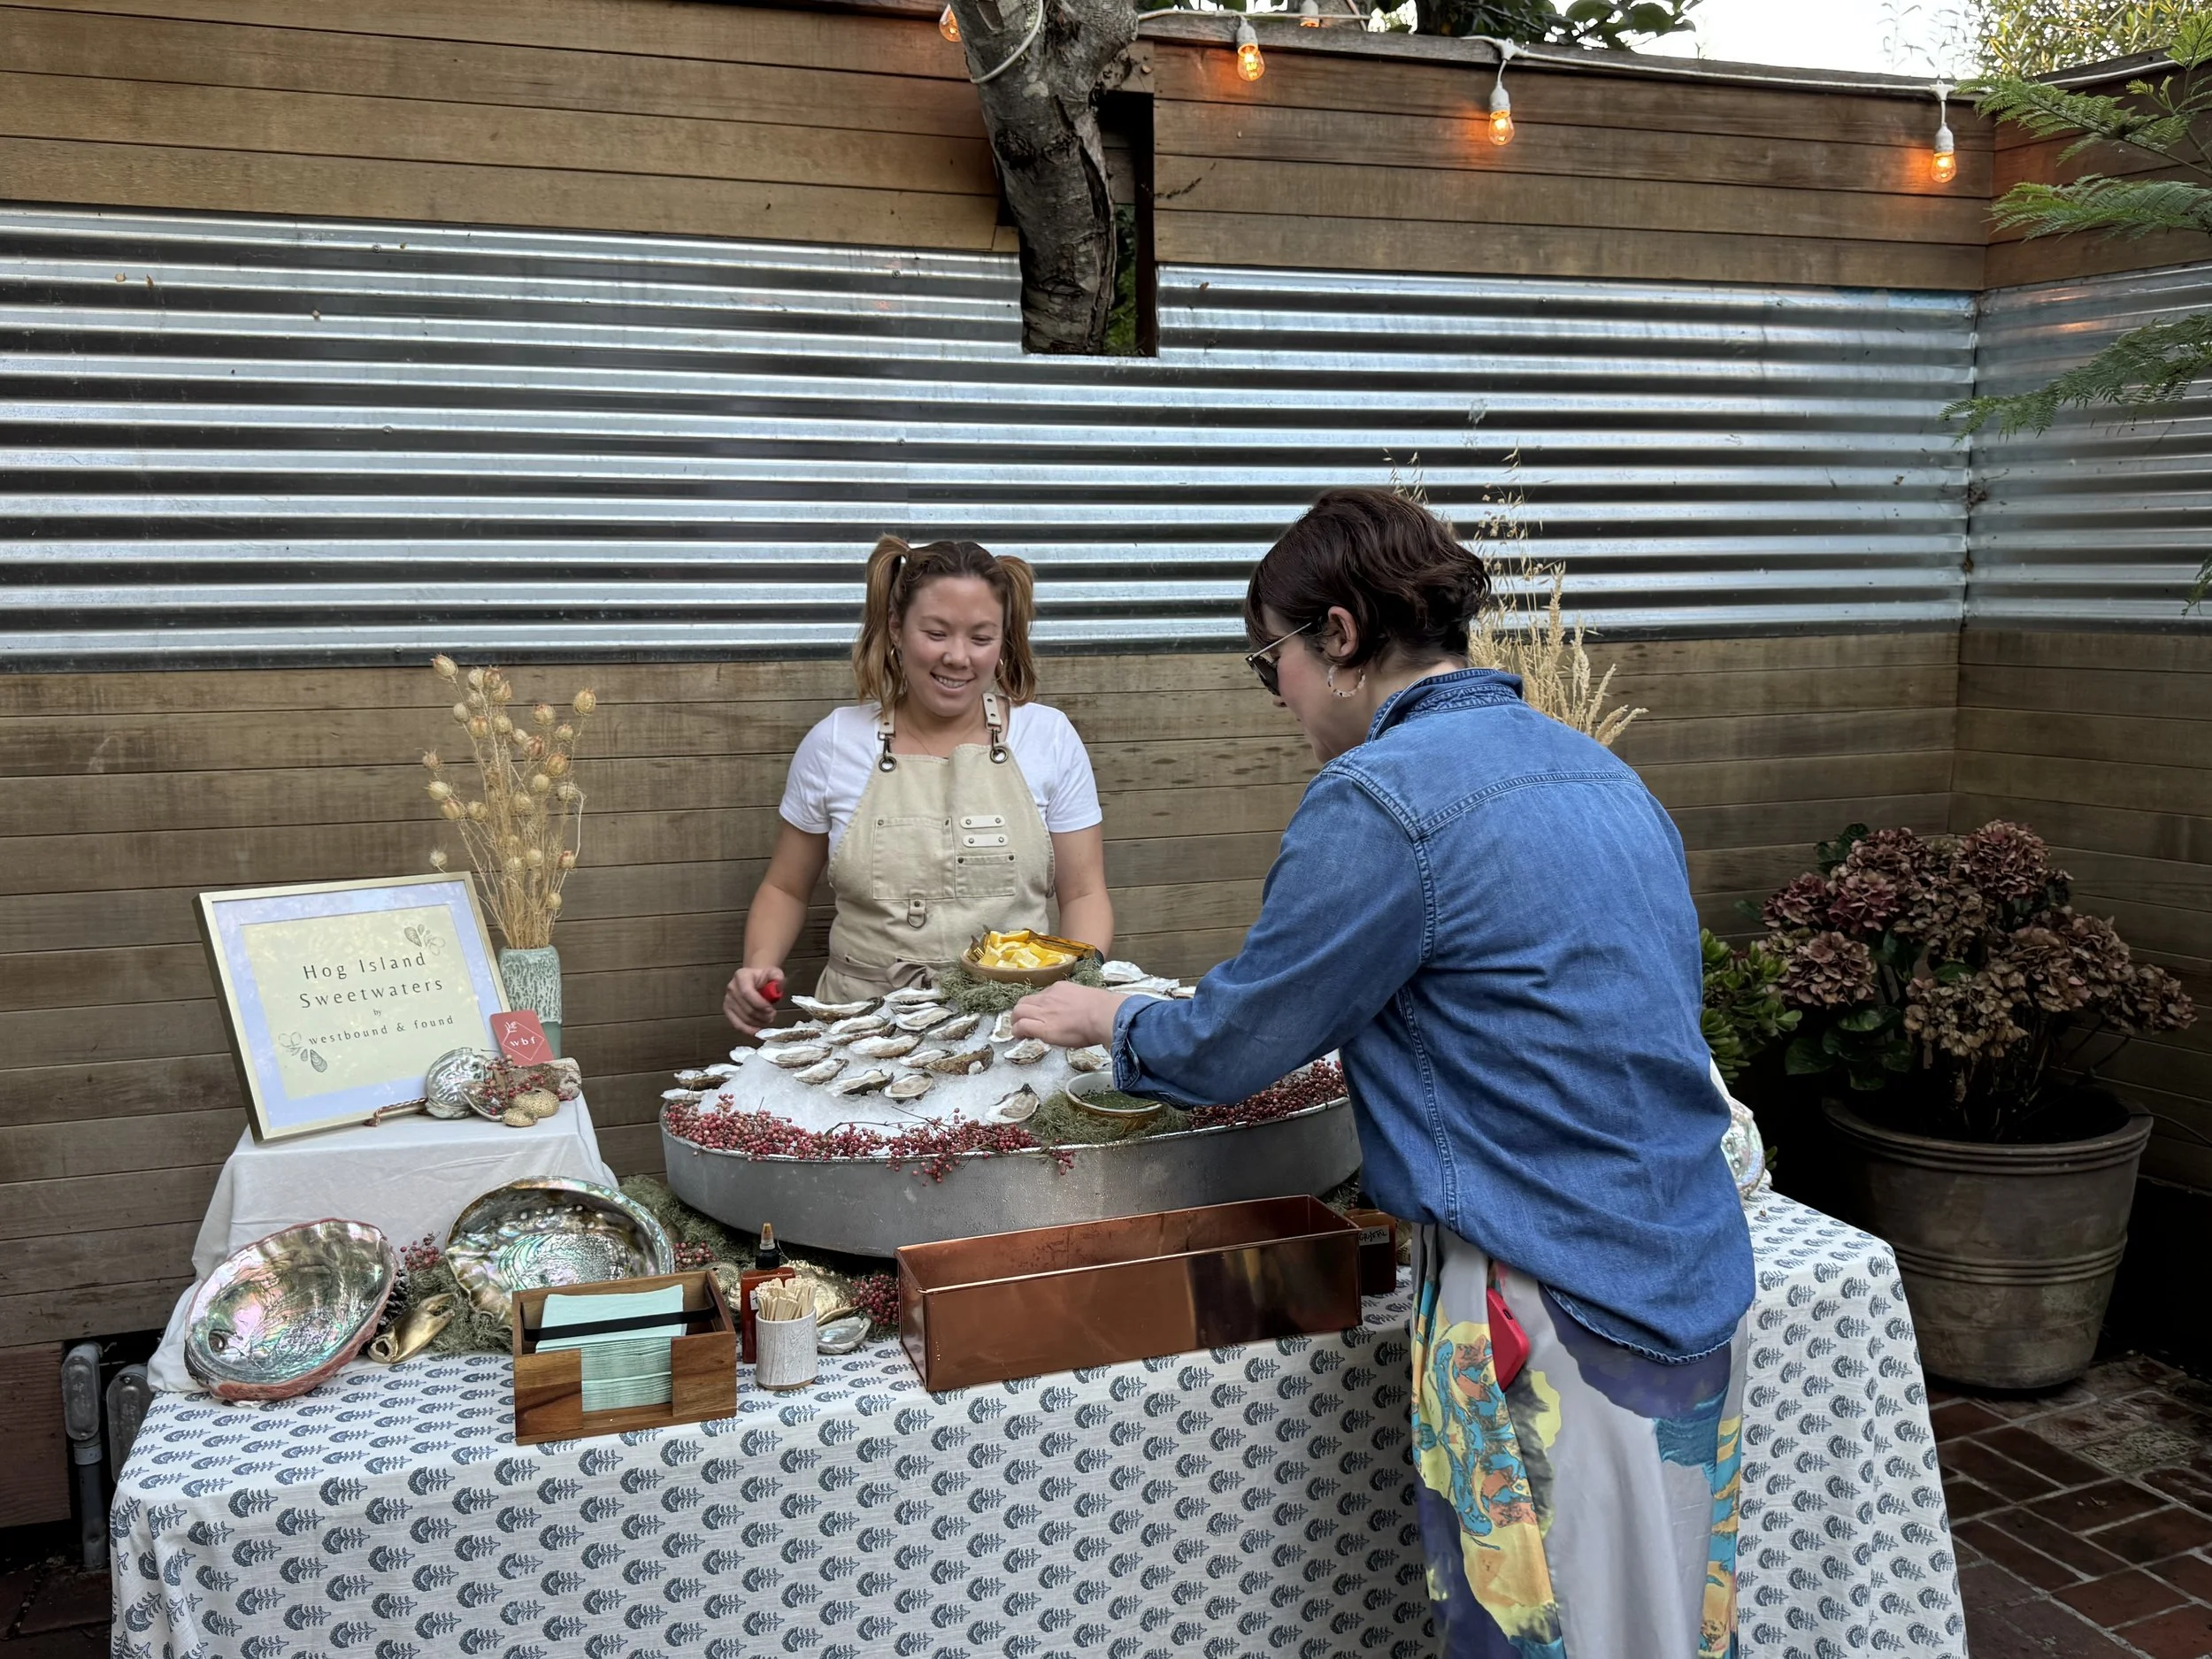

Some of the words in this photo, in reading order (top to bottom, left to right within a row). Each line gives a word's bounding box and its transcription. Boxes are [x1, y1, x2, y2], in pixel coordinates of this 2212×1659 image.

[303, 964, 347, 980] Hog
[358, 952, 426, 973] Island
[299, 979, 443, 1009] Sweetwaters
[309, 1025, 388, 1045] westbound
[396, 1022, 406, 1033] &
[413, 1015, 454, 1029] found
